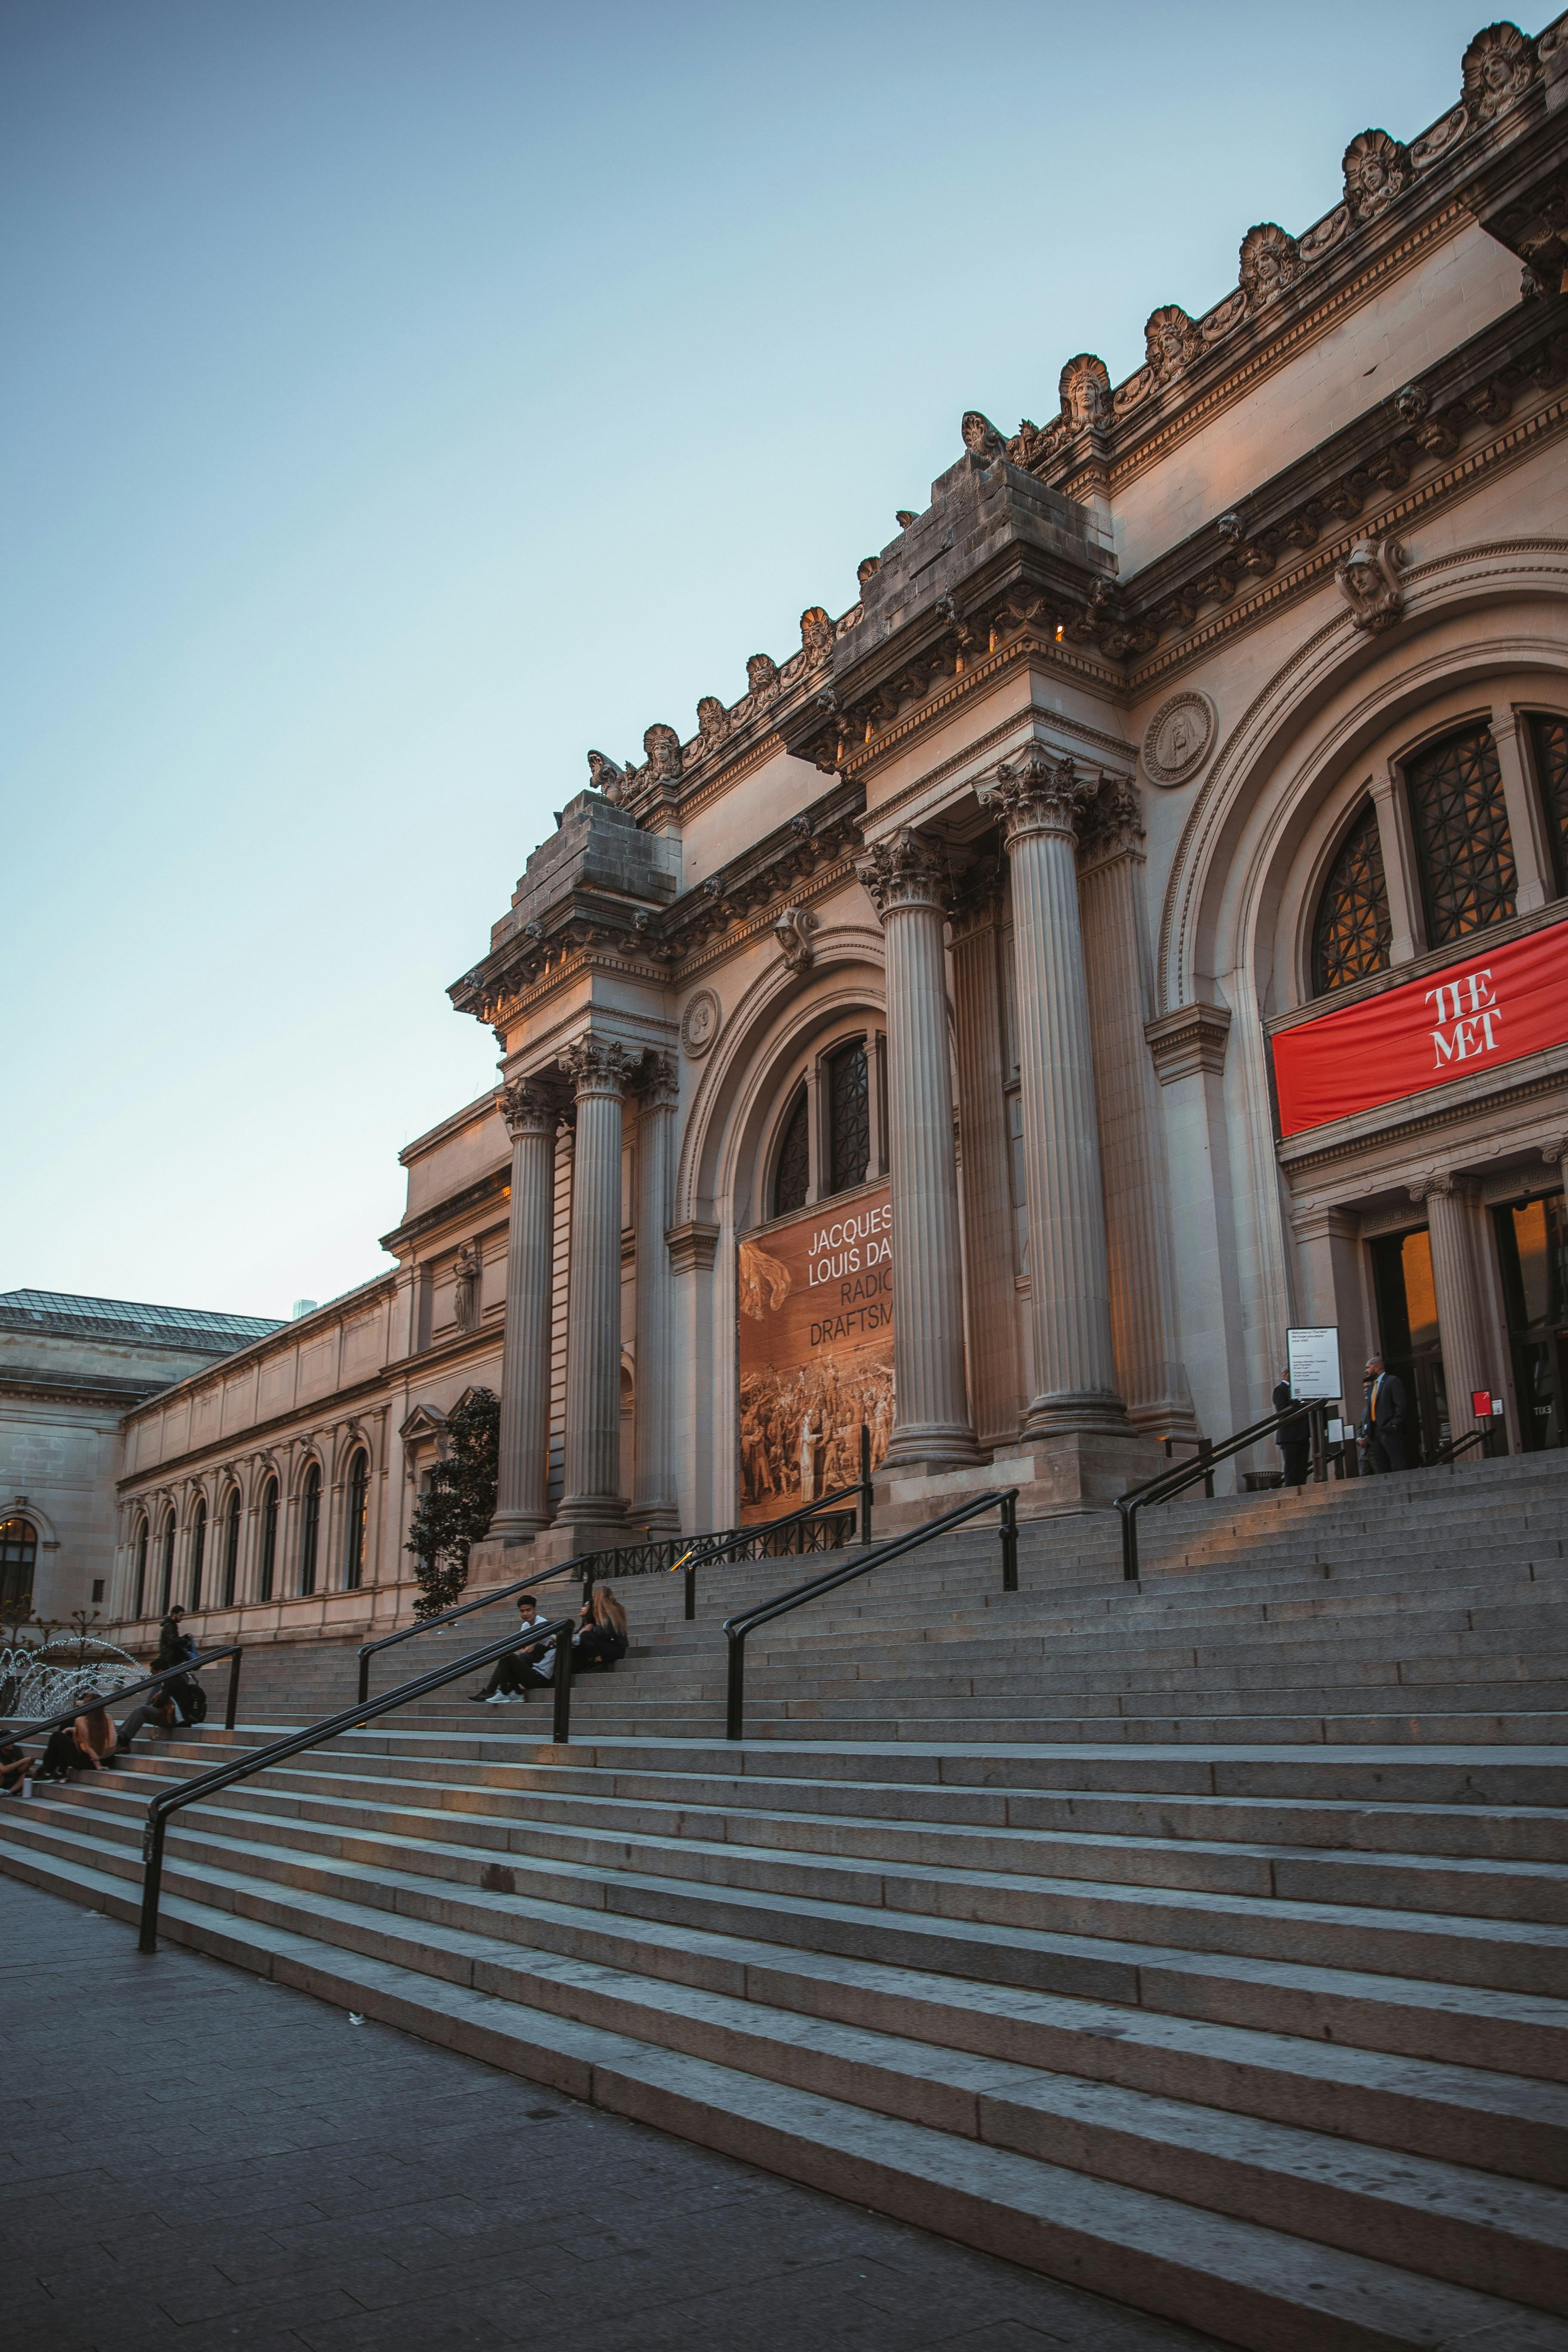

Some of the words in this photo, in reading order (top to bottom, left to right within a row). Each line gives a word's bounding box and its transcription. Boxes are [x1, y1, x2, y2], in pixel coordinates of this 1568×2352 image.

[1424, 968, 1496, 1026] THE
[1428, 1008, 1503, 1070] MET
[808, 1204, 892, 1256] JACQUES
[808, 1248, 860, 1286] LOUIS
[866, 1235, 892, 1267] DA
